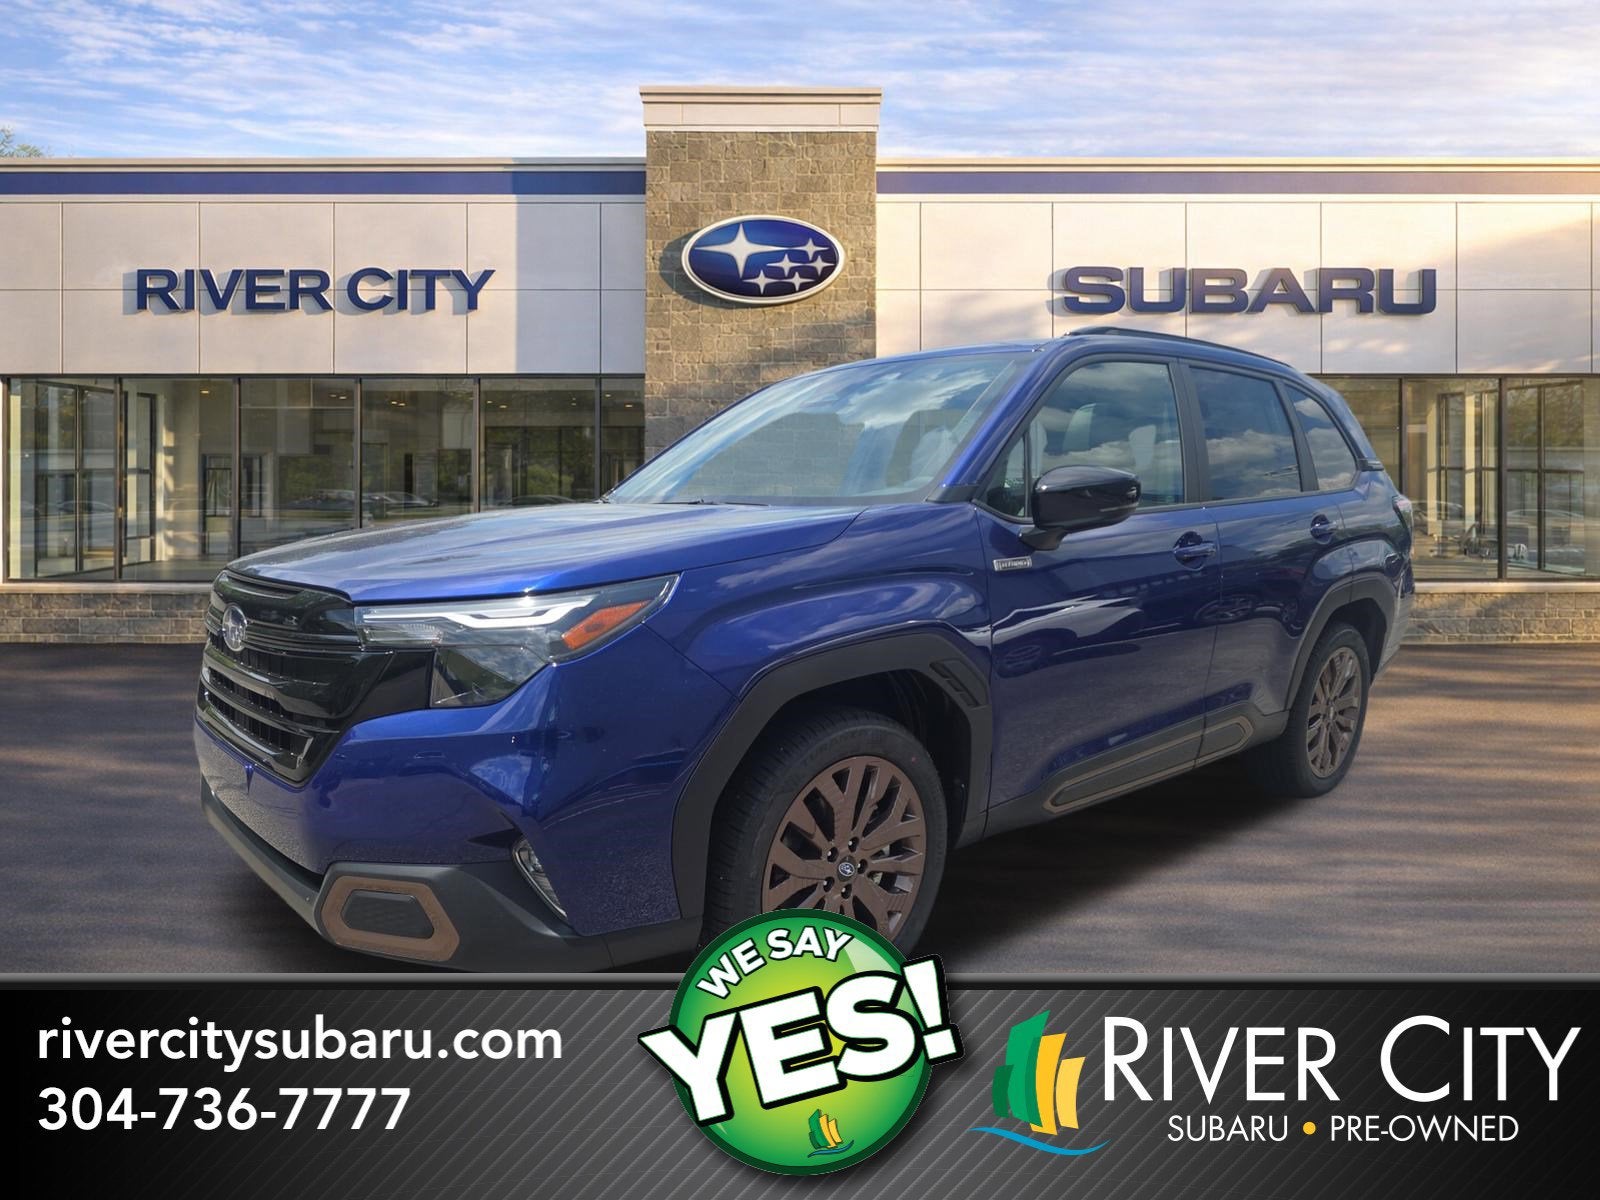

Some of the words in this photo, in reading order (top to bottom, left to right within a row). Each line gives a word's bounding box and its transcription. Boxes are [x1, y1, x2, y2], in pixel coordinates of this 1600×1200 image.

[136, 268, 332, 312] RIVER
[347, 268, 495, 311] CITY
[1063, 266, 1437, 315] SUBARU
